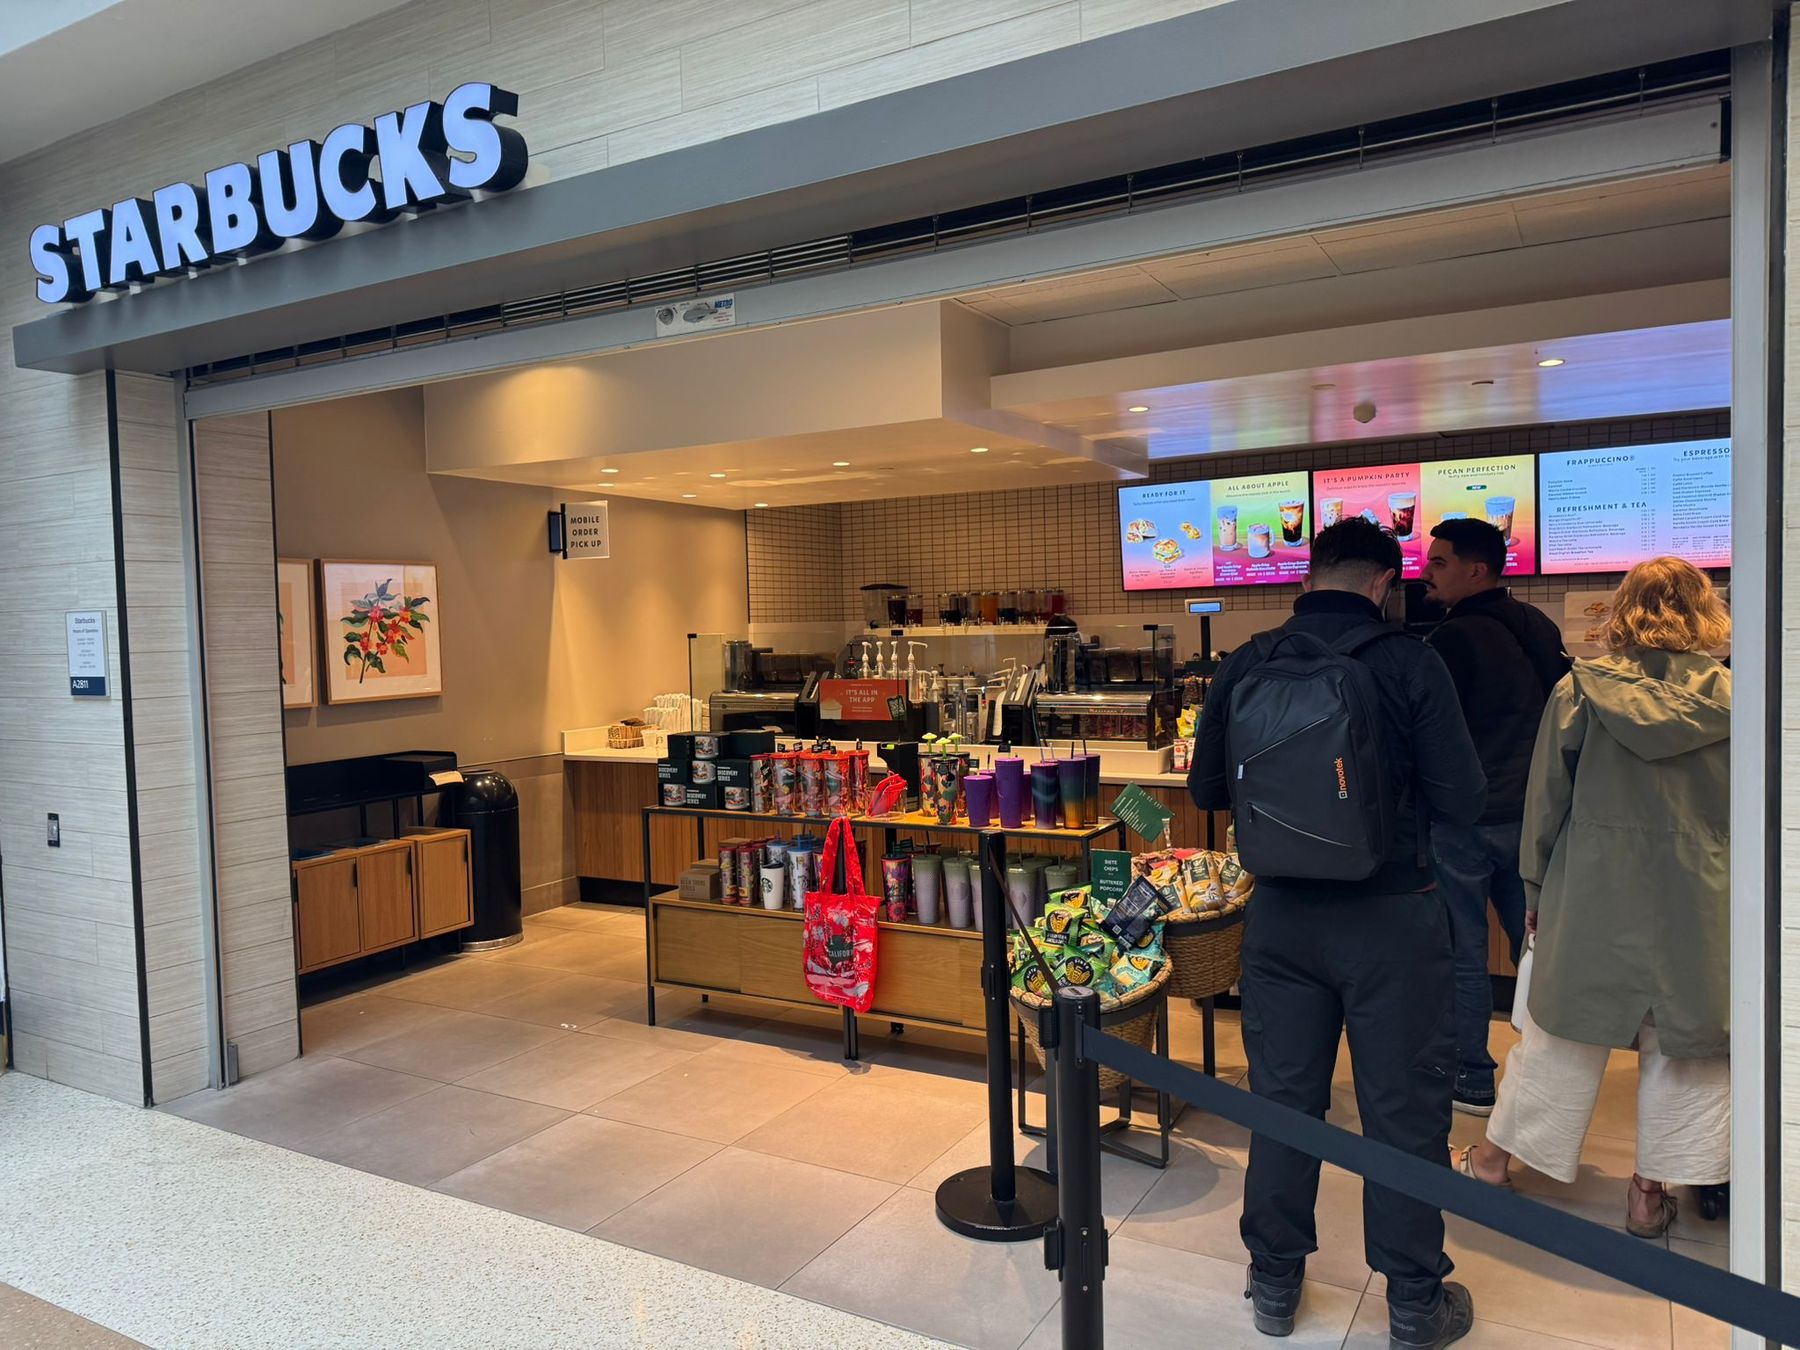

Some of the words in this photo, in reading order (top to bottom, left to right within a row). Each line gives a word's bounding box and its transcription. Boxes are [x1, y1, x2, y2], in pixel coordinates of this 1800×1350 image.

[28, 82, 505, 303] STARBUCKS
[1684, 448, 1730, 456] ESPRESSO
[1466, 464, 1516, 473] PERFECTION
[1557, 503, 1618, 512] REFRESHMENT
[570, 516, 600, 524] MOBILE
[73, 680, 88, 688] A2811
